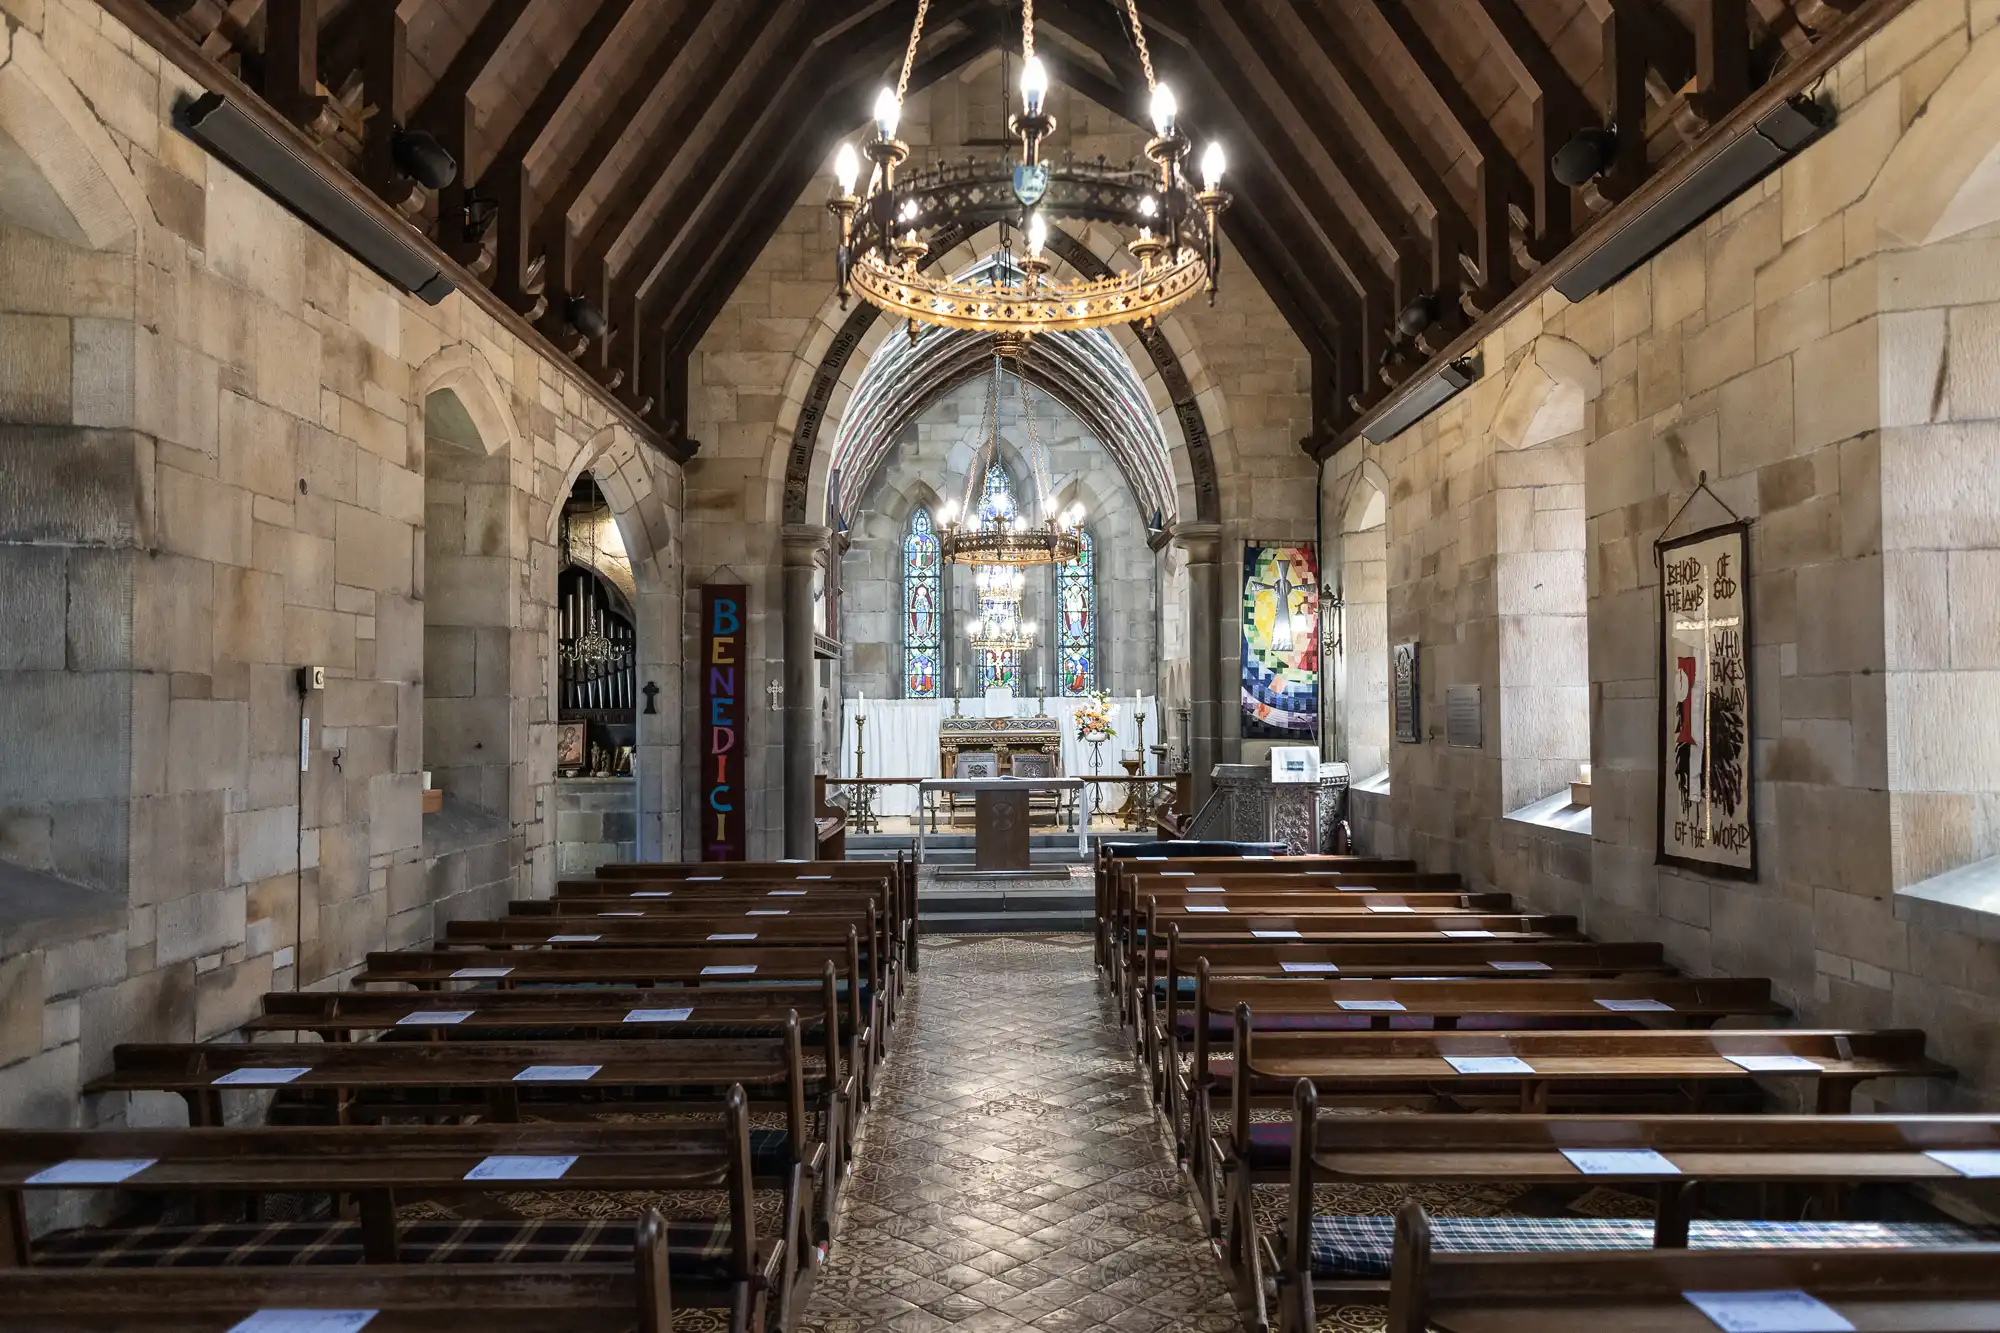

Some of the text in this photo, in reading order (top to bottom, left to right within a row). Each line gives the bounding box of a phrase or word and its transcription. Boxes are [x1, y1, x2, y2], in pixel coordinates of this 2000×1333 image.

[1666, 557, 1702, 586] BEHOLD
[1717, 552, 1732, 579] OF
[1665, 584, 1704, 613] THE LAMB
[1713, 578, 1737, 600] GOD
[1713, 629, 1741, 659] WHO
[1710, 657, 1745, 686] TAKES
[1674, 820, 1751, 855] OF THE WORLD
